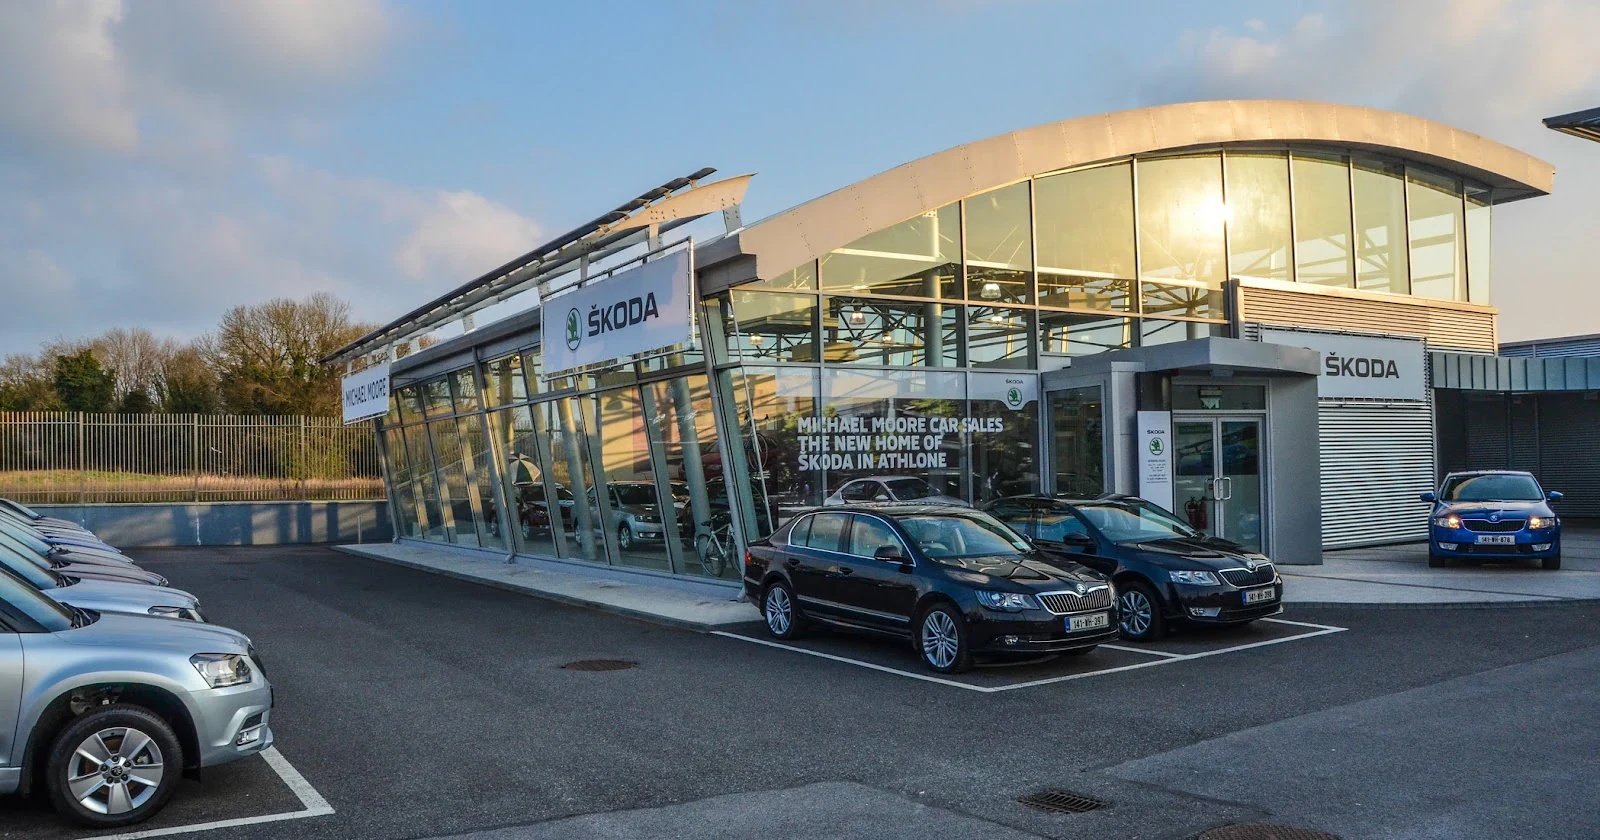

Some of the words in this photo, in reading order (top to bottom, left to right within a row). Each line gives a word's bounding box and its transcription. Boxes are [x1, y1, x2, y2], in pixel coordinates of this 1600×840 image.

[588, 292, 659, 337] ŠKODA
[1325, 351, 1400, 379] ŠKODA
[345, 385, 367, 407] MICHAEL
[367, 377, 386, 401] MOORE
[797, 416, 869, 433] MICHAEL
[871, 416, 927, 433] MOORE
[929, 417, 959, 433] CAR
[961, 417, 1004, 433] SALES
[797, 435, 830, 452] THE
[834, 435, 872, 452] NEW
[875, 434, 921, 451] HOME
[923, 434, 943, 451] OF
[798, 450, 855, 472] ŠKODA
[857, 453, 874, 470] IN
[877, 452, 947, 470] ATHLONE
[1073, 615, 1104, 629] 141-WH-397
